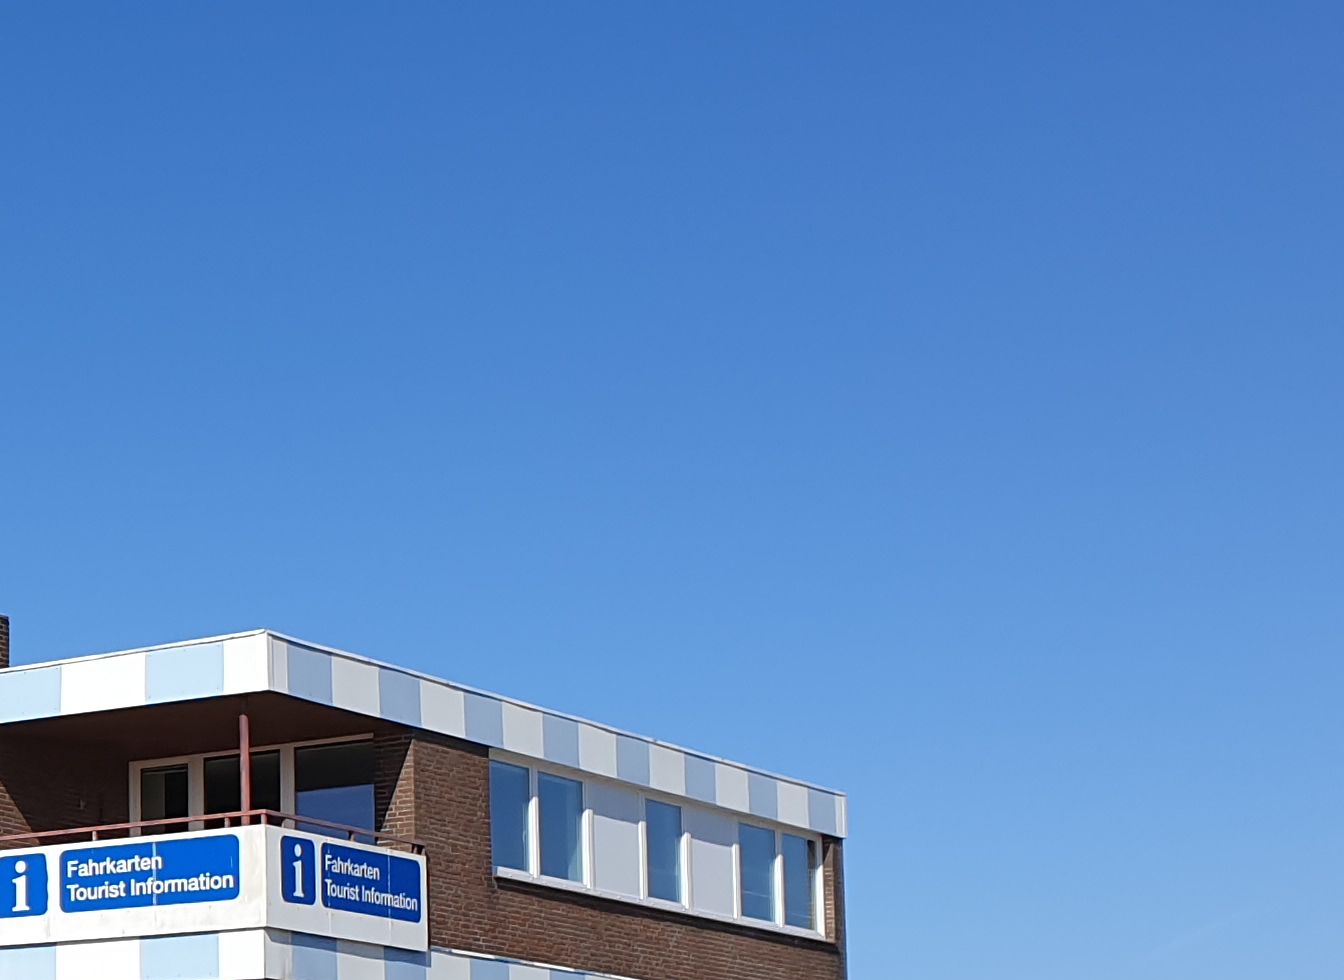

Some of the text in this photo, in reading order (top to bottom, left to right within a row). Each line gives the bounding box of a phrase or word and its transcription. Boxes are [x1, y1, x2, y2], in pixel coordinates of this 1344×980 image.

[66, 855, 163, 878] Fahrkarten
[324, 854, 380, 881] Fahrkarten
[66, 872, 234, 902] Tourist Information
[324, 879, 418, 912] Tourist Information
